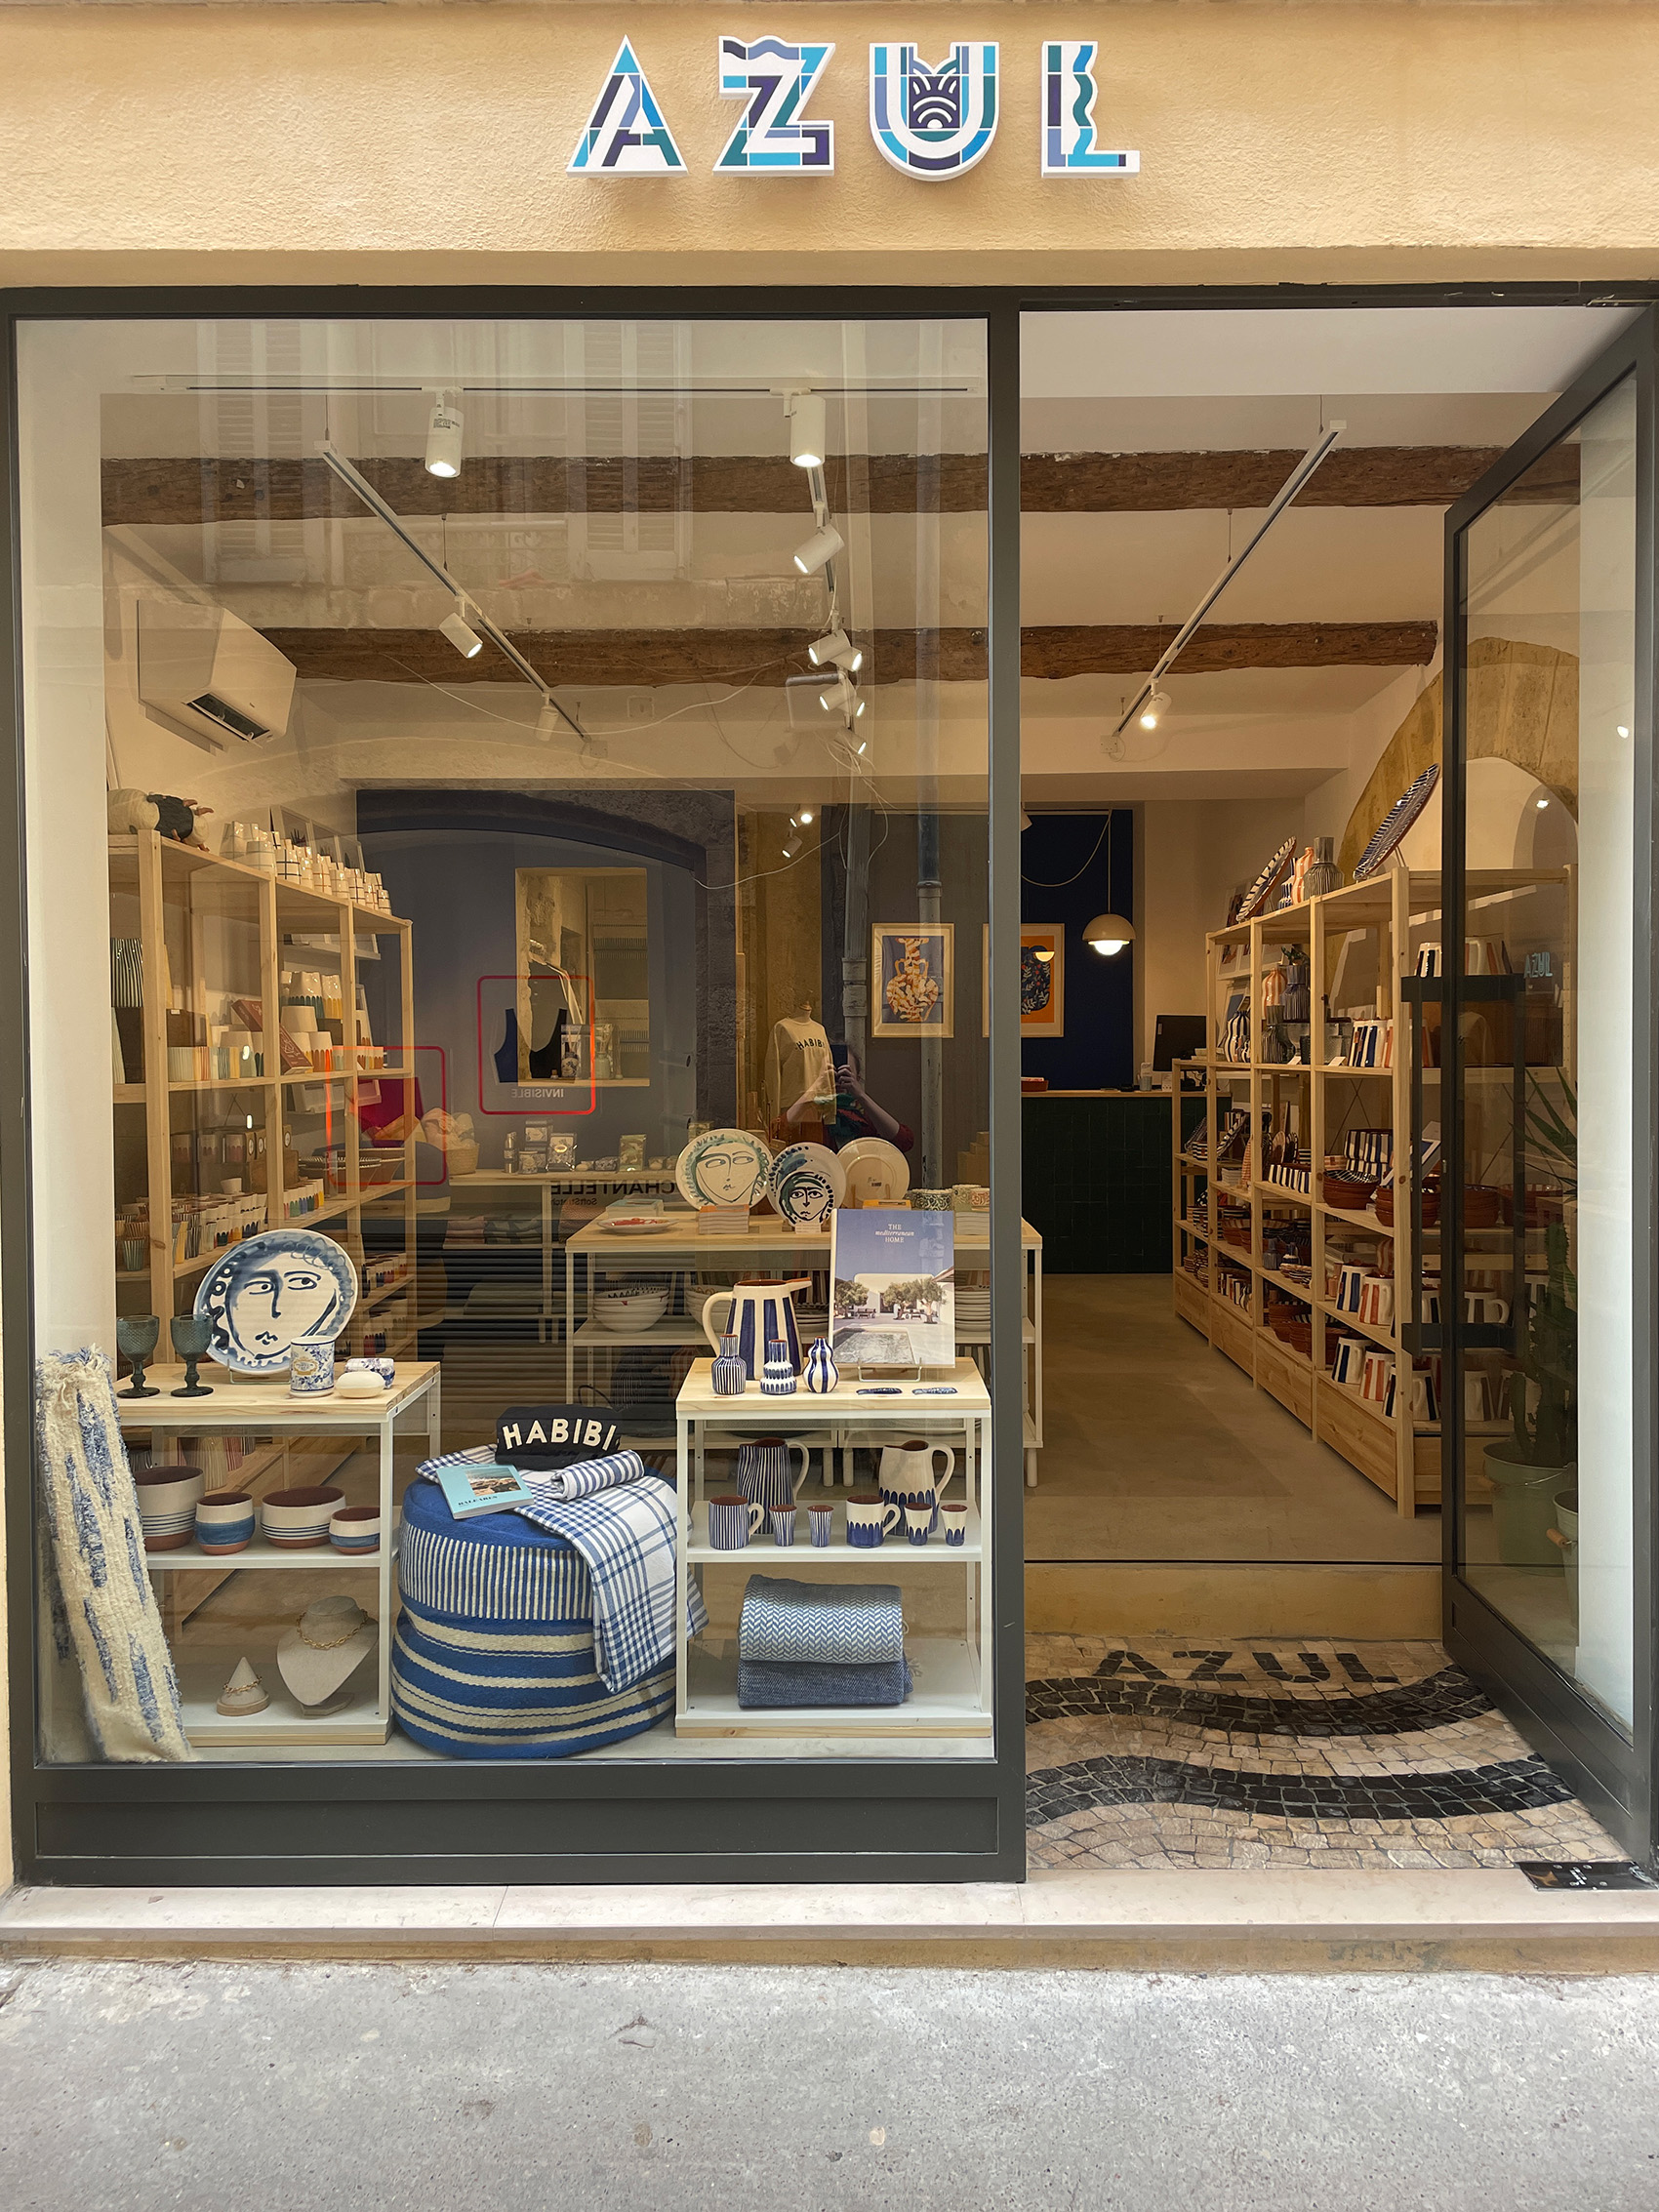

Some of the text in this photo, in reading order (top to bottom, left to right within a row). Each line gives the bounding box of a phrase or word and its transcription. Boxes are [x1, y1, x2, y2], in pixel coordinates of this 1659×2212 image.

[566, 34, 1140, 181] AZUL
[1523, 951, 1553, 979] AZUL
[502, 1418, 617, 1451] HABIBI
[1091, 1650, 1399, 1684] AZUL
